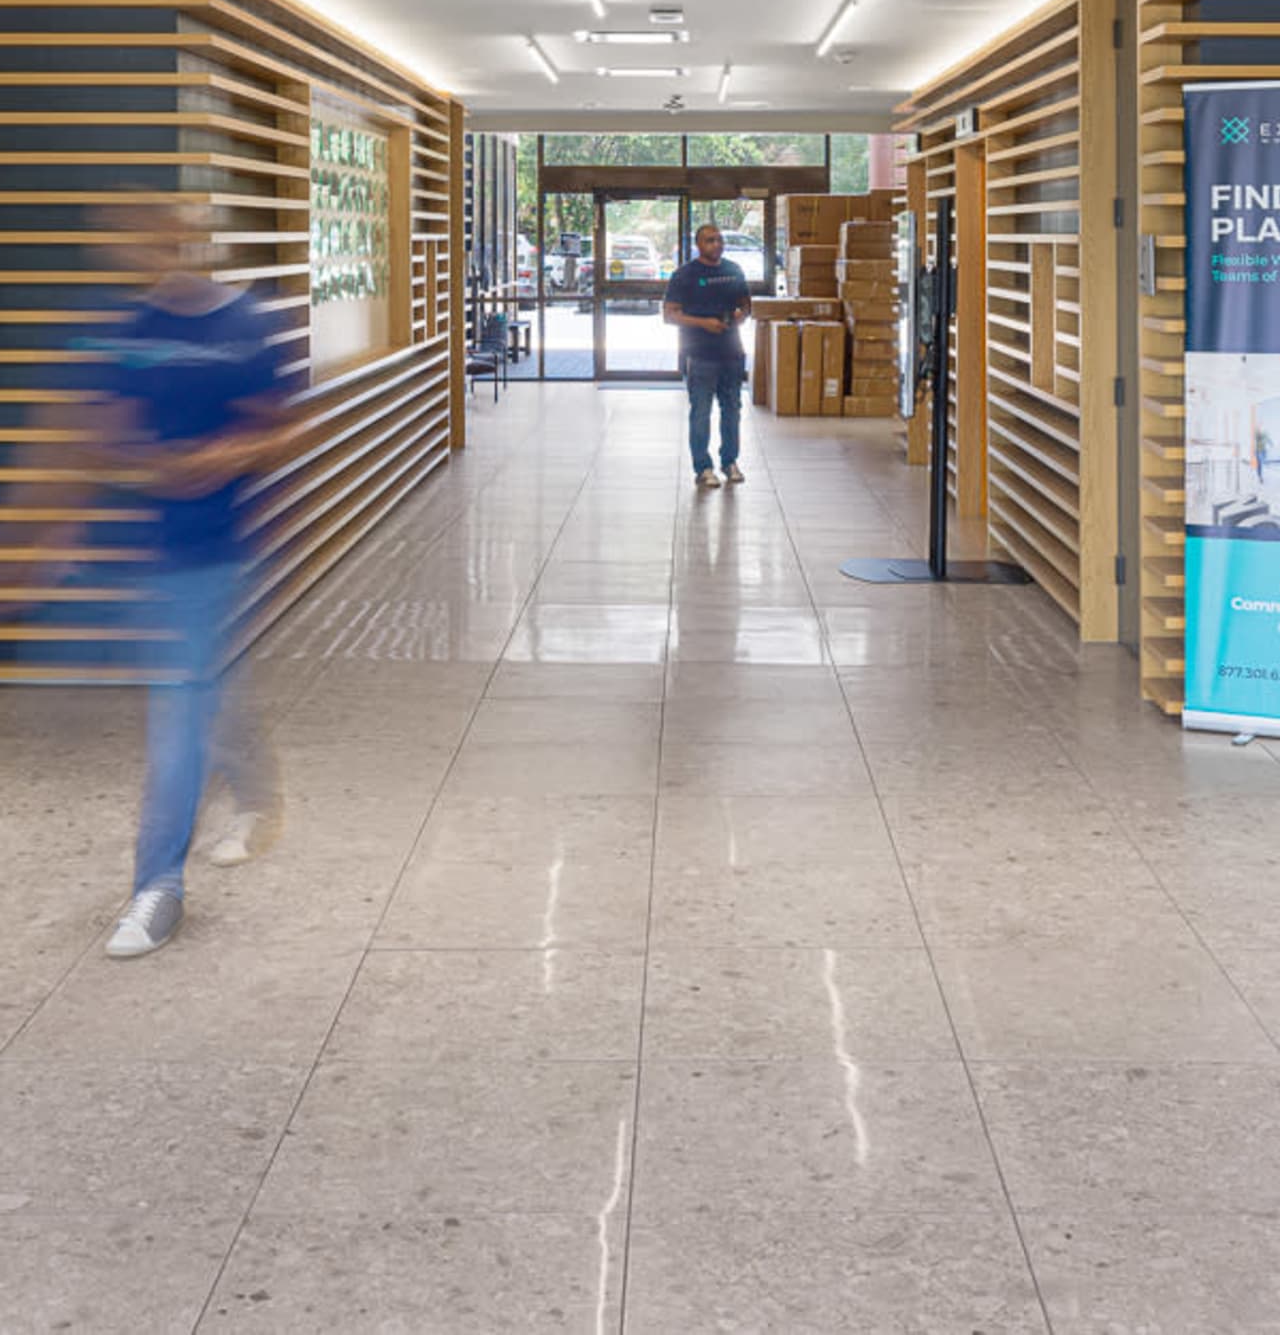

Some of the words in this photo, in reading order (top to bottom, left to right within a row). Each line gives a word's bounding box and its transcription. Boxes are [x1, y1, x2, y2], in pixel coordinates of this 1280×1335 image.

[1211, 253, 1268, 267] Flexible
[1211, 269, 1260, 283] Teams
[1262, 269, 1277, 282] of
